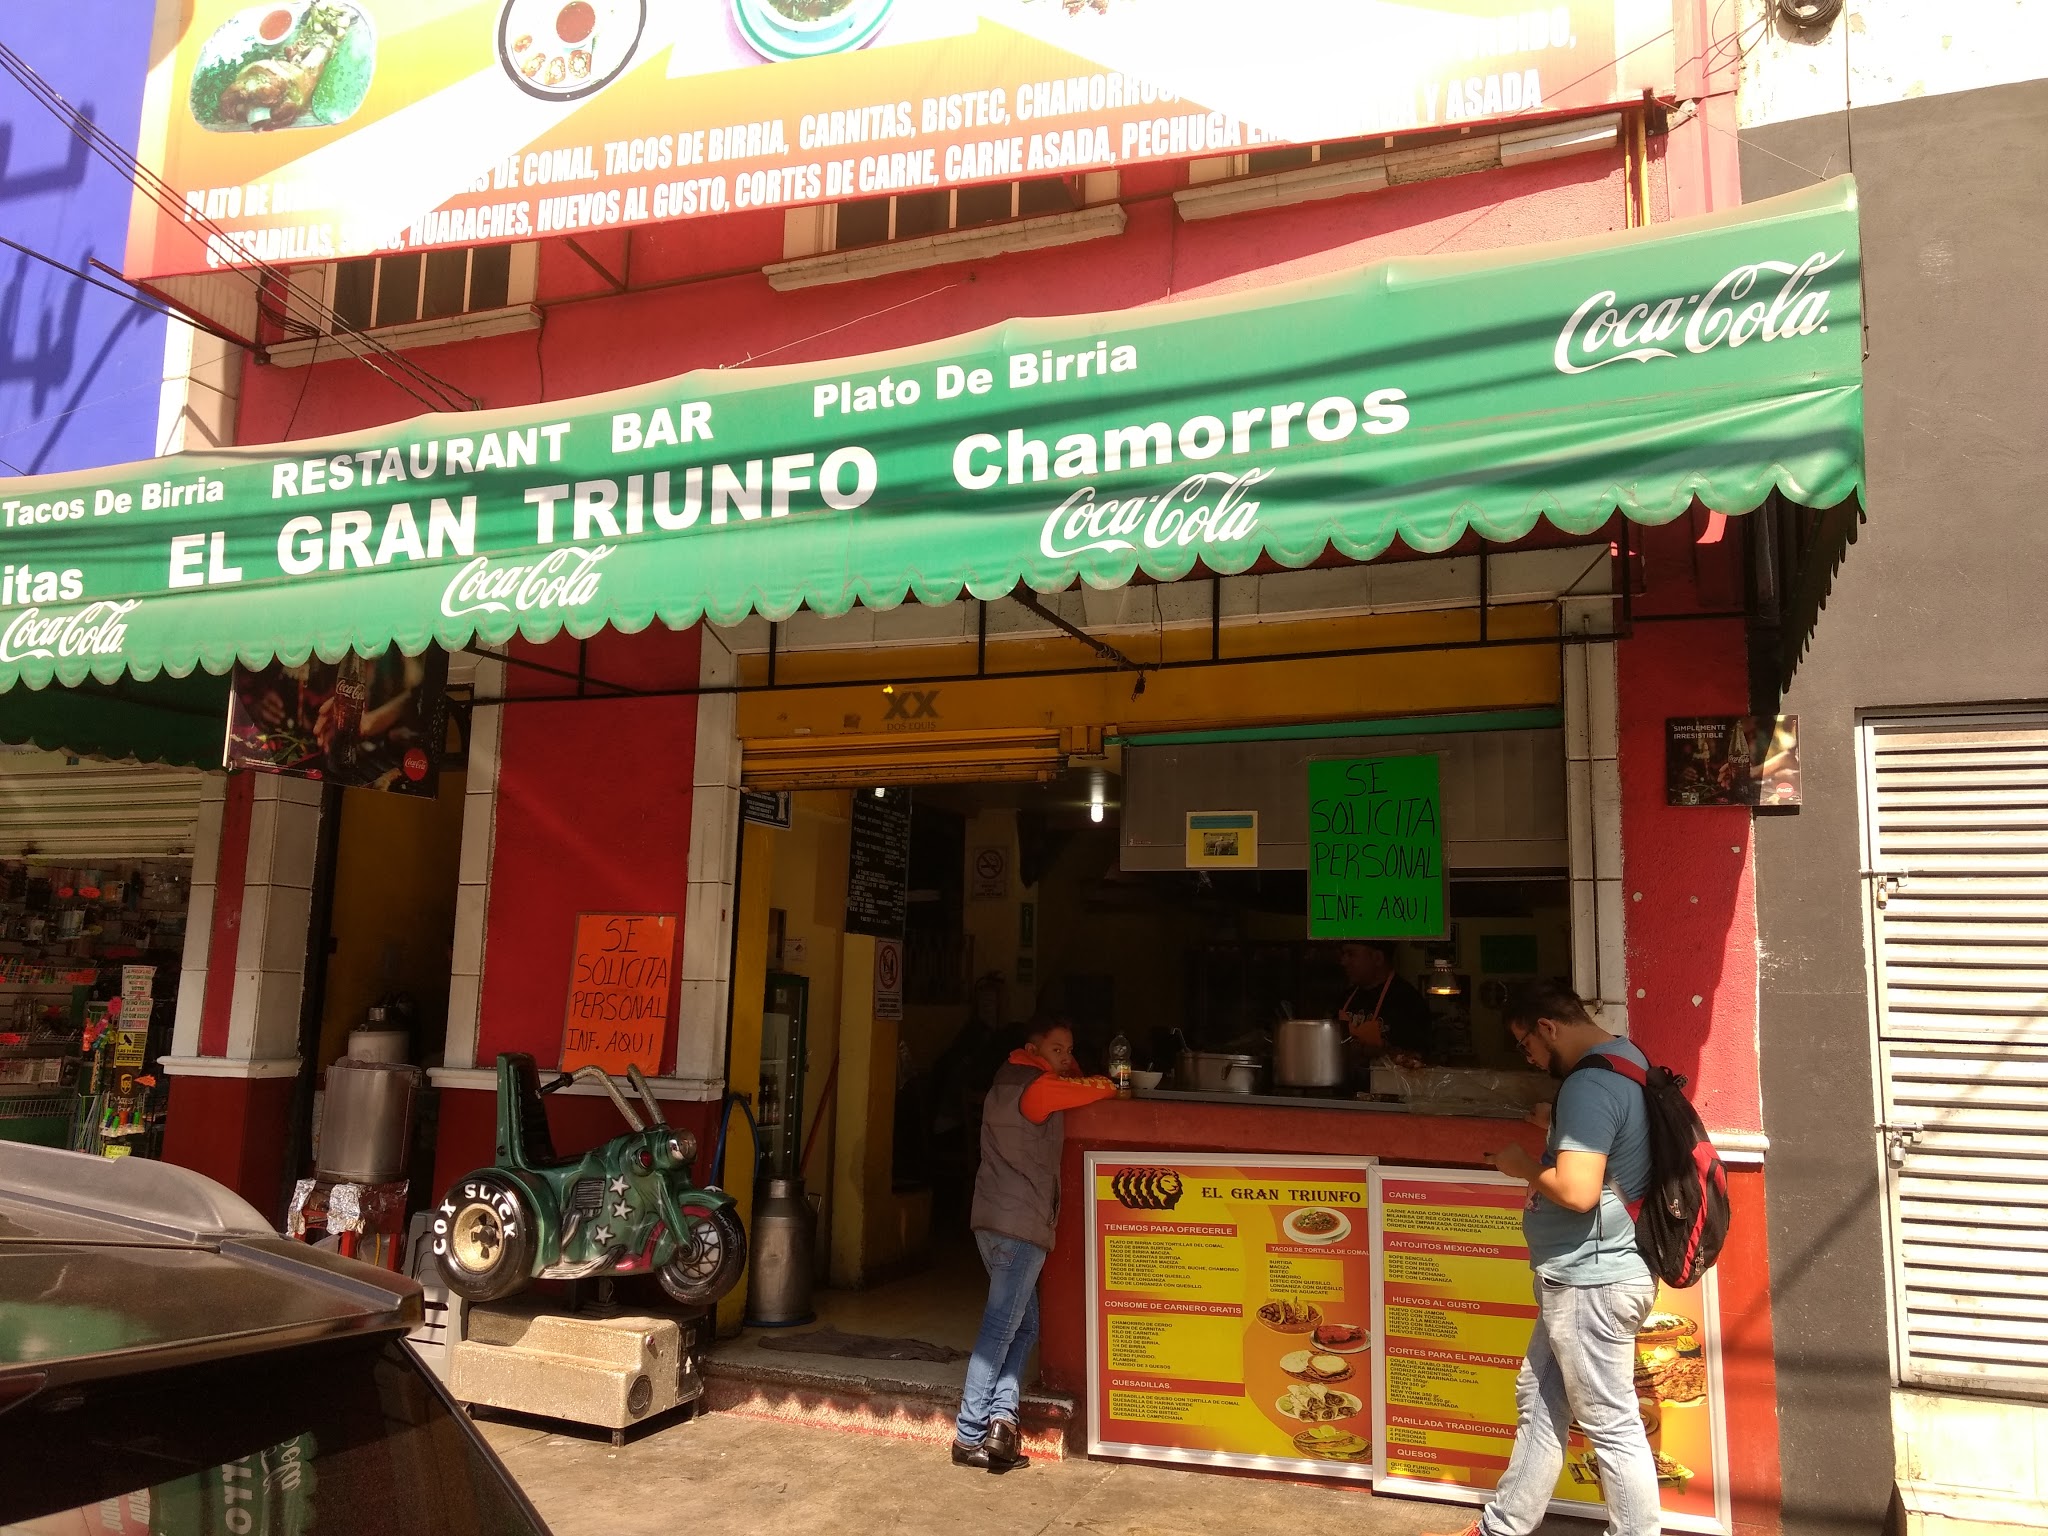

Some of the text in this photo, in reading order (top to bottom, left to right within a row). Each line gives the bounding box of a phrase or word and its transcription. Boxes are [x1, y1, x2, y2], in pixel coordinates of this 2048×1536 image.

[184, 186, 242, 222] PLATO
[498, 155, 519, 190] DE
[523, 145, 599, 185] COMAL,
[604, 134, 673, 176] TACOS
[676, 130, 704, 168] DE
[708, 119, 789, 162] BIRRIA,
[799, 101, 916, 150] CARNITAS,
[922, 87, 1010, 134] BISTEC,
[409, 201, 532, 247] HUARACHES,
[536, 187, 621, 233] HUEVOS
[623, 185, 649, 221] AL
[653, 175, 729, 218] GUSTO,
[735, 162, 821, 208] CORTES
[825, 158, 854, 197] DE
[858, 148, 939, 191] CARNE,
[944, 136, 1023, 182] CARNE
[1026, 125, 1117, 171] ASADA,
[1121, 111, 1241, 160] PECHUGA
[1446, 68, 1542, 120] ASADA
[813, 341, 1137, 417] Plato De Birria
[272, 402, 713, 499] RESTAURANT BAR
[952, 387, 1409, 490] Chamorros
[3, 477, 223, 527] Tacos De Birria
[169, 446, 877, 588] EL GRAN TRIUNFO
[883, 690, 941, 719] XX
[1673, 724, 1726, 732] SIMPLEMENTE
[1343, 762, 1387, 797] SE
[1311, 798, 1435, 838] SOLICITA
[1314, 843, 1440, 880] PERSONAL
[1315, 894, 1428, 923] INF. AQUI
[601, 918, 644, 953] SE
[577, 954, 667, 988] SOLICITA
[572, 991, 666, 1021] PERSONAL
[566, 1028, 654, 1055] INF. AQUI
[1201, 1187, 1361, 1203] EL GRAN TRIUNFO
[1389, 1191, 1426, 1199] CARNES
[434, 1184, 516, 1255] COX SLICK
[1104, 1224, 1233, 1235] TENEMOS PARA OFRECERLE
[1390, 1240, 1499, 1254] ANTOJITOS MEXICANOS
[1105, 1301, 1148, 1309] CONSOME
[1164, 1304, 1207, 1312] CARNERO
[1210, 1306, 1241, 1314] GRATIS
[1393, 1296, 1430, 1306] HUEVOS
[1447, 1301, 1480, 1310] GUSTO
[1389, 1347, 1513, 1365] CORTES PARA EL PALADAR
[1392, 1416, 1511, 1435] PARILLADA TRADICIONAL
[1397, 1449, 1437, 1459] QUESOS
